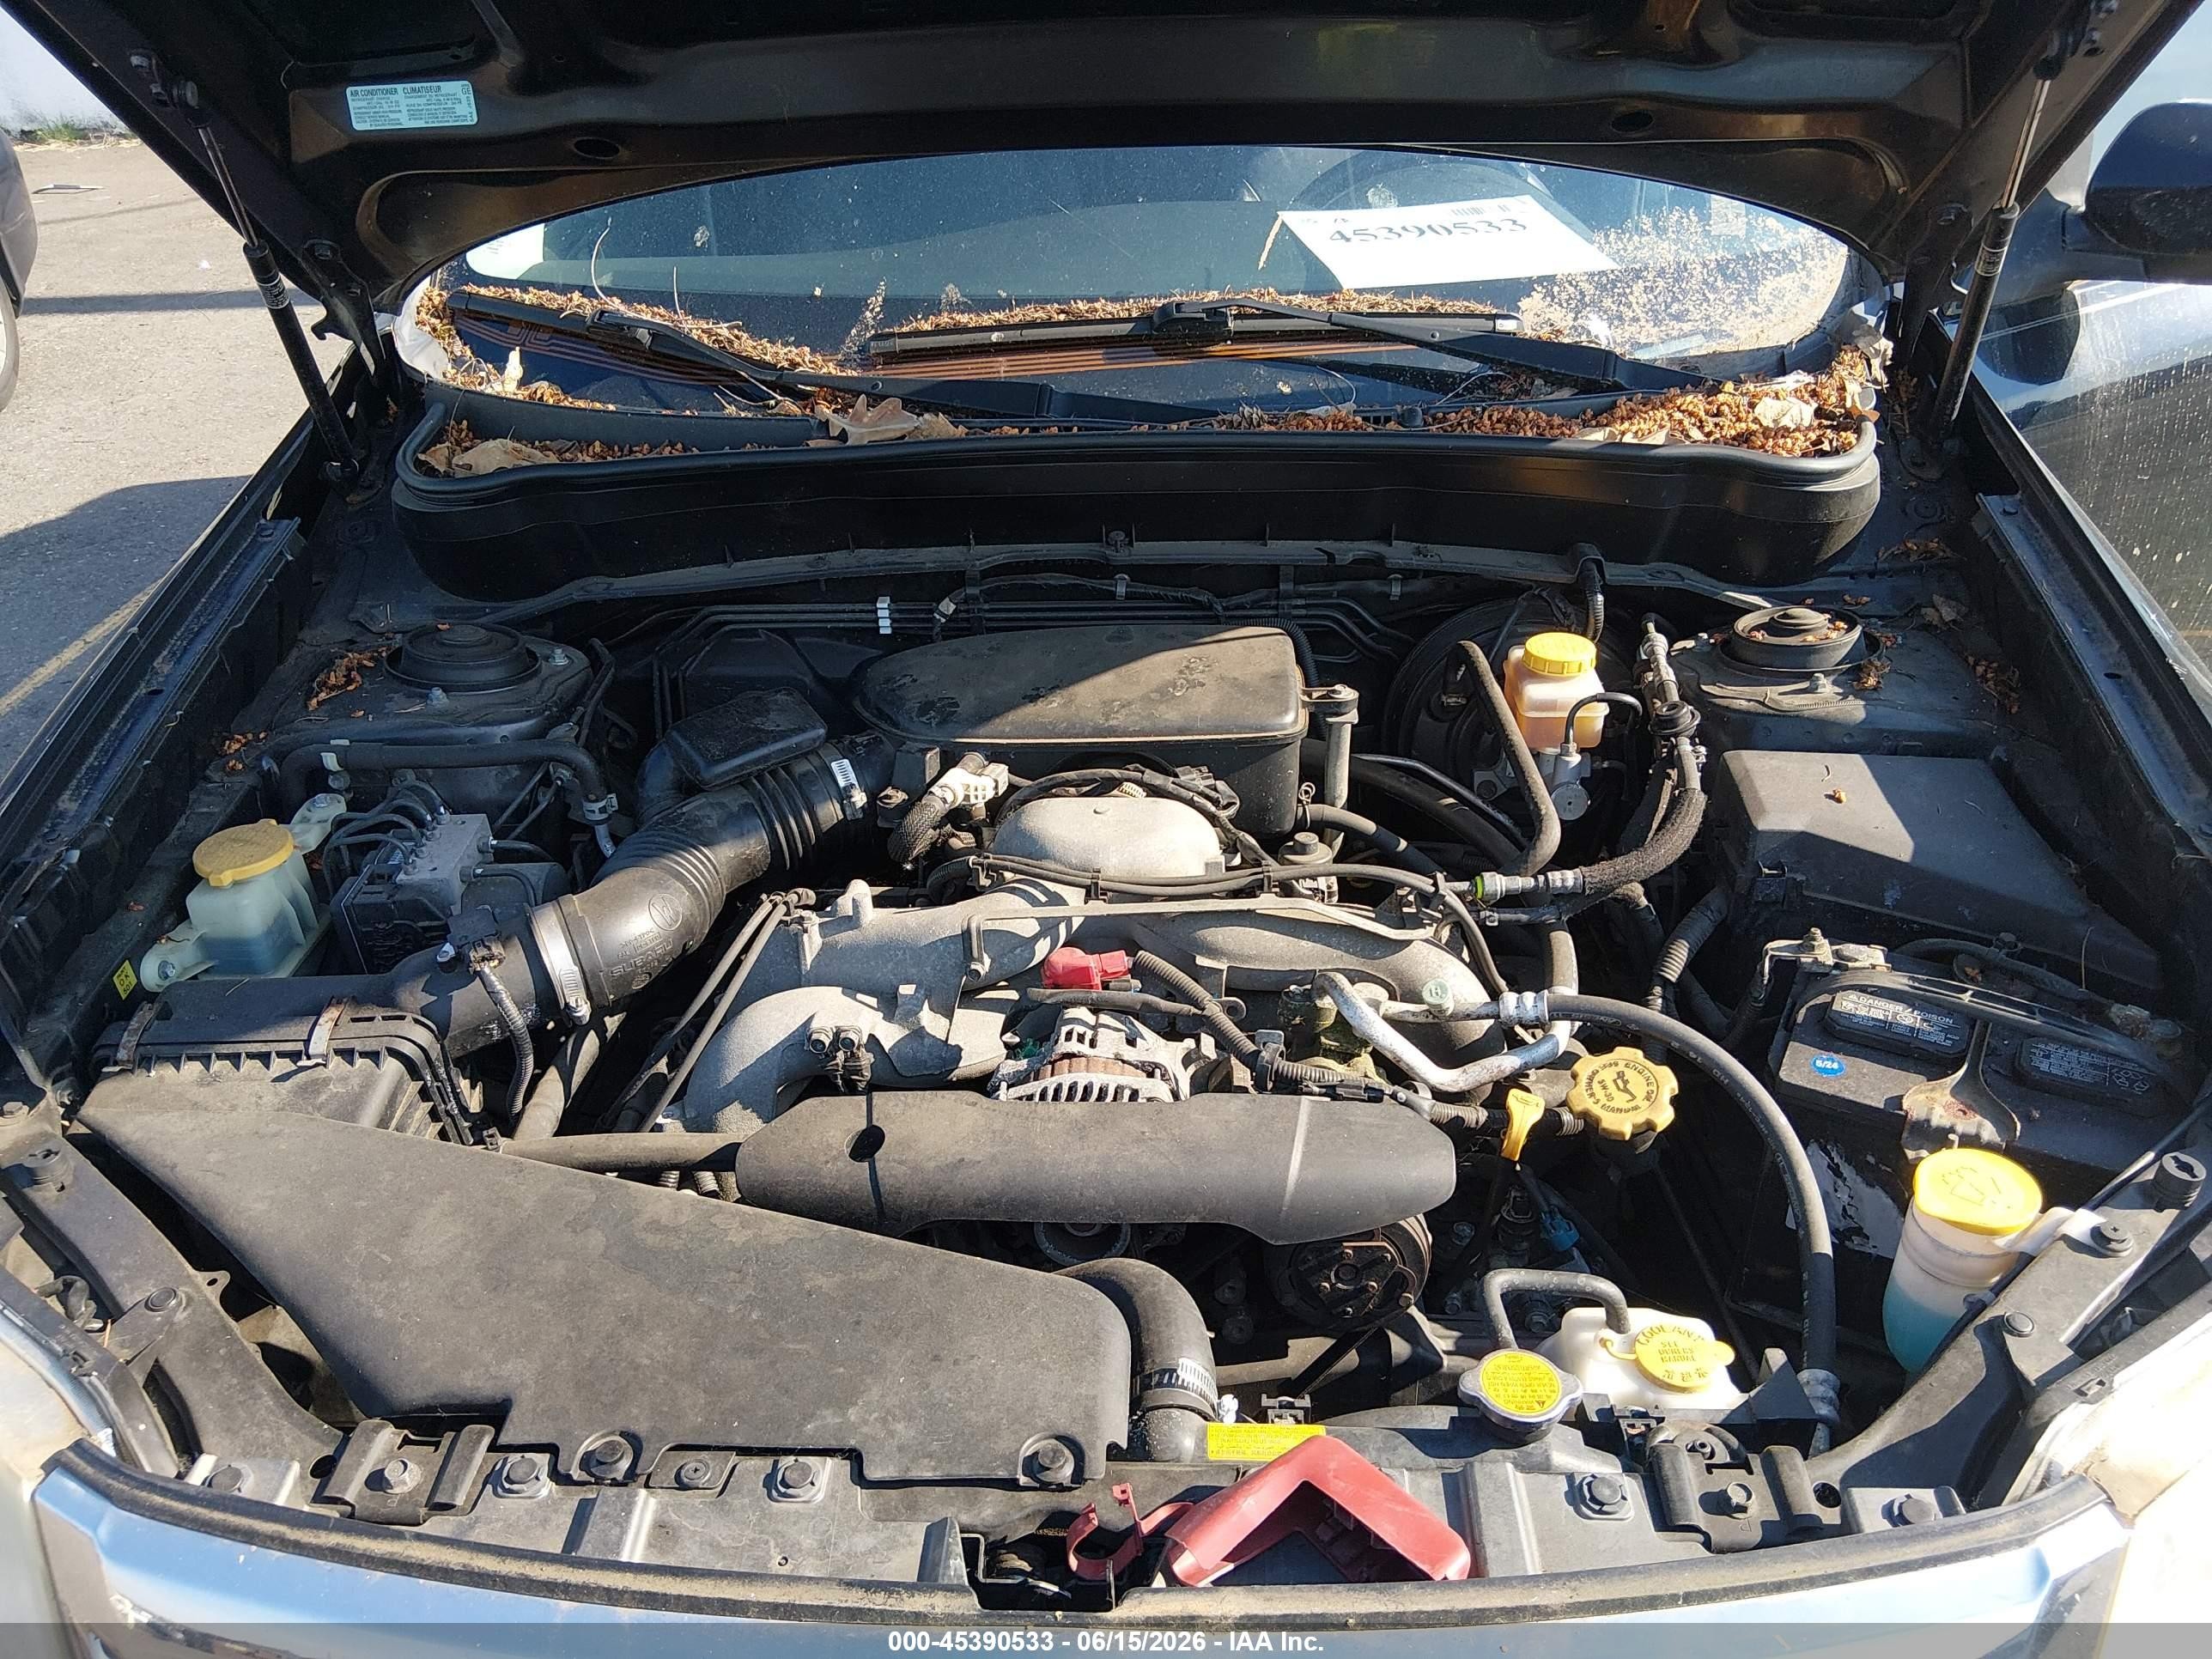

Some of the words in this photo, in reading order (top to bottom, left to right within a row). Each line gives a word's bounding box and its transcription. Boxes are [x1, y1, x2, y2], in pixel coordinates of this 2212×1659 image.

[349, 88, 360, 97] AIR
[360, 87, 399, 97] CONDITIONER
[403, 84, 442, 94] CLIMATISEUR
[1329, 218, 1527, 242] 45390533
[611, 938, 674, 977] SUBARU
[1859, 996, 1904, 1013] DANGER
[1913, 1009, 1954, 1024] POISON
[1624, 1061, 1655, 1087] ENGINE
[1815, 1058, 1838, 1071] 5/24
